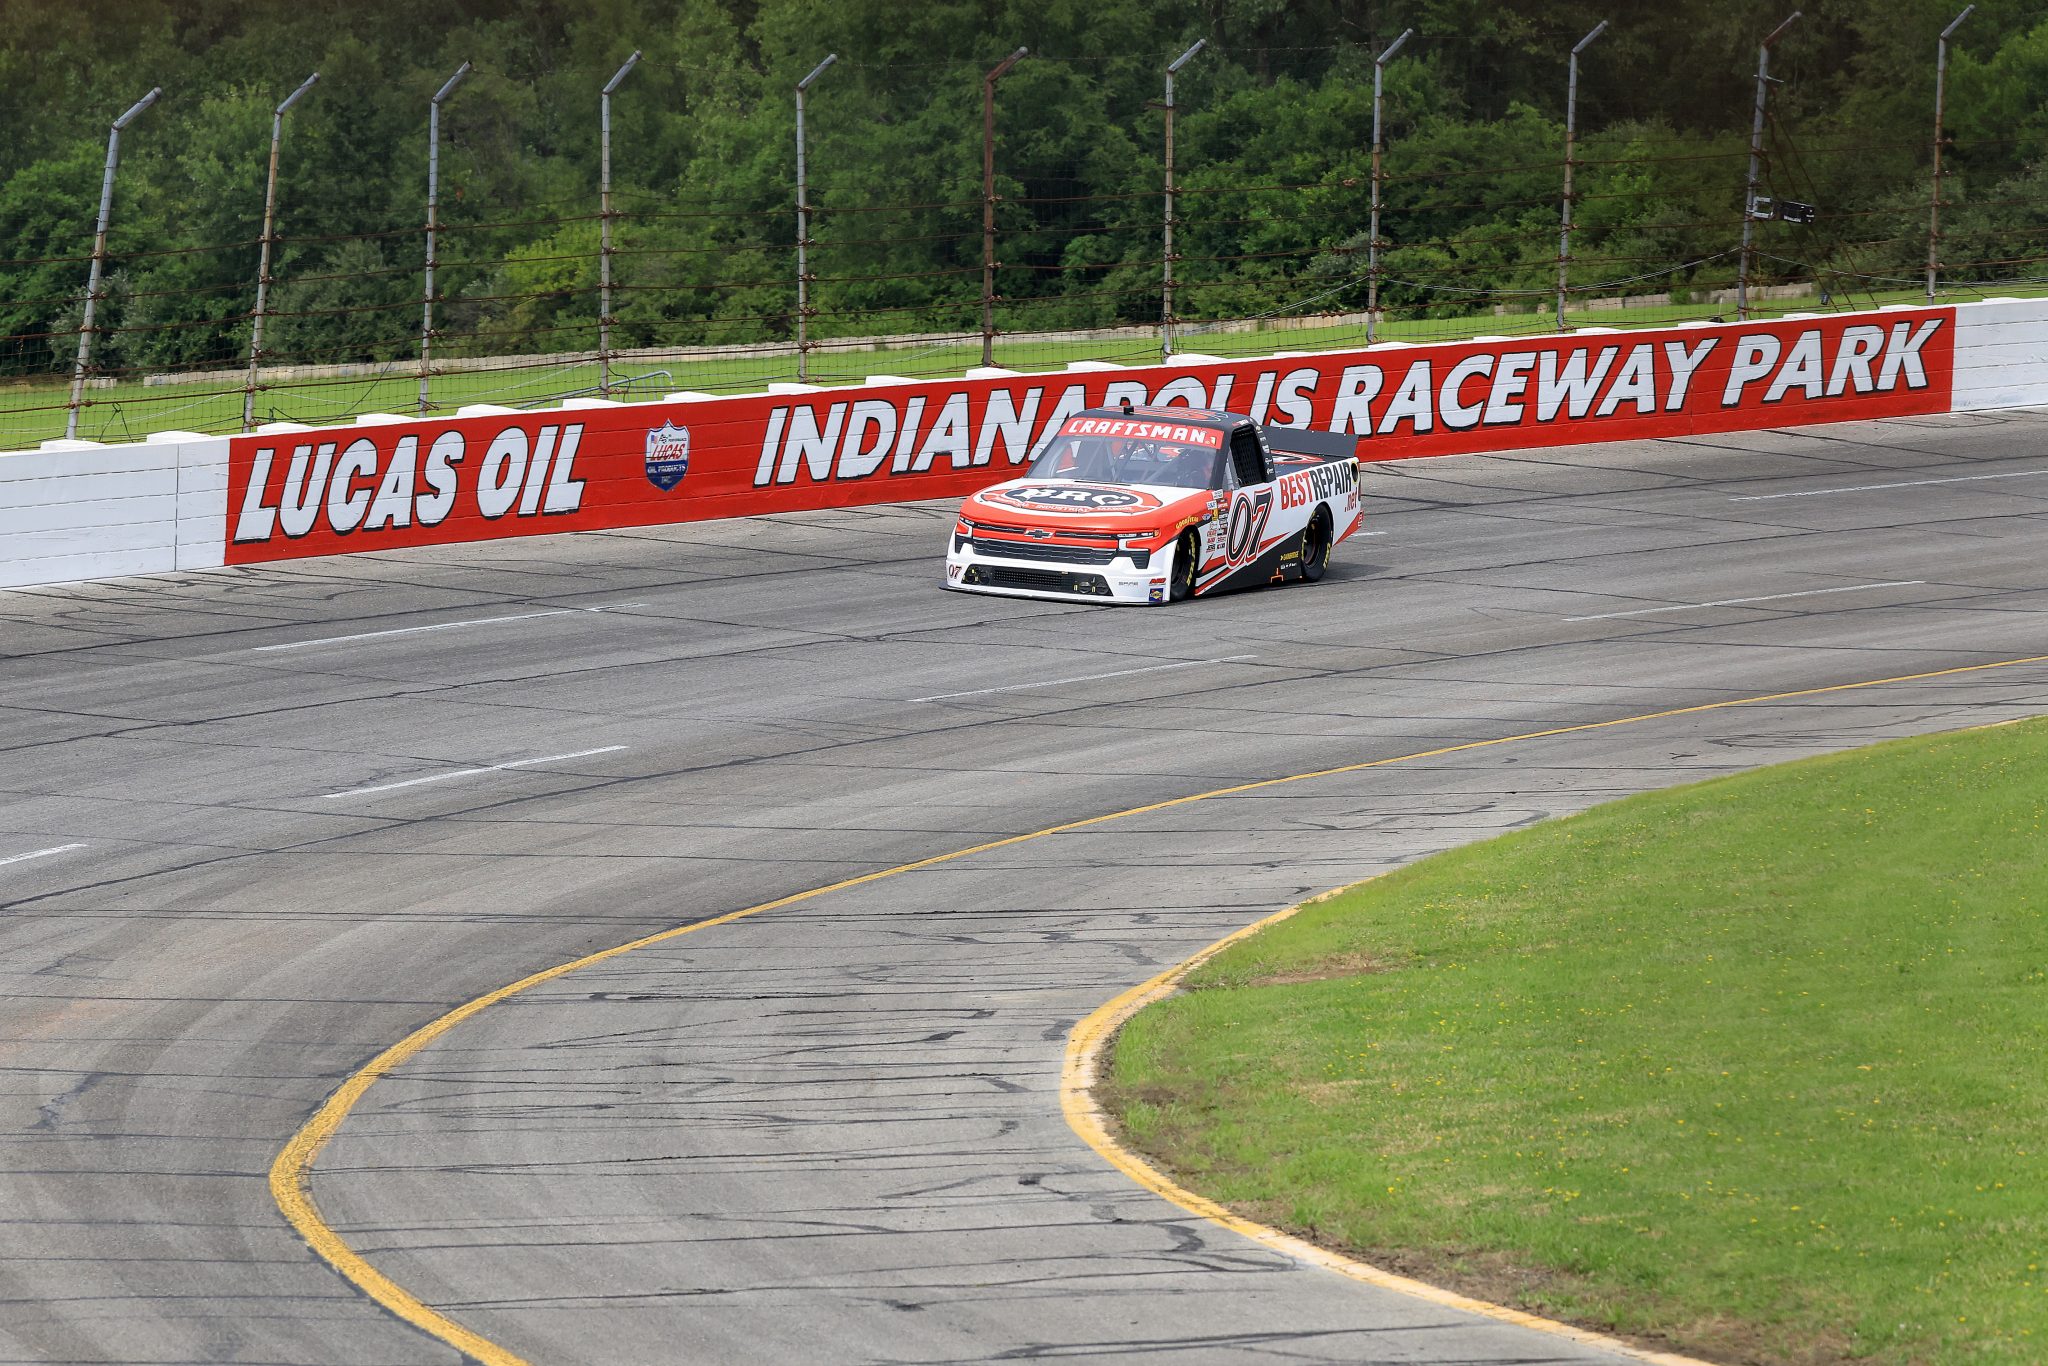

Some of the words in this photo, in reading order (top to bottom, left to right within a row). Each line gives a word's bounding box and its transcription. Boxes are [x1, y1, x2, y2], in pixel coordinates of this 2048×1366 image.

[233, 430, 466, 544] LUCAS
[476, 422, 587, 520] OIL
[1327, 337, 1721, 437] RACEWAY
[1721, 318, 1945, 409] PARK
[1068, 420, 1207, 444] CRAFTSMAN
[651, 443, 686, 461] LUCAS
[1225, 486, 1275, 570] 07
[949, 563, 963, 580] 07
